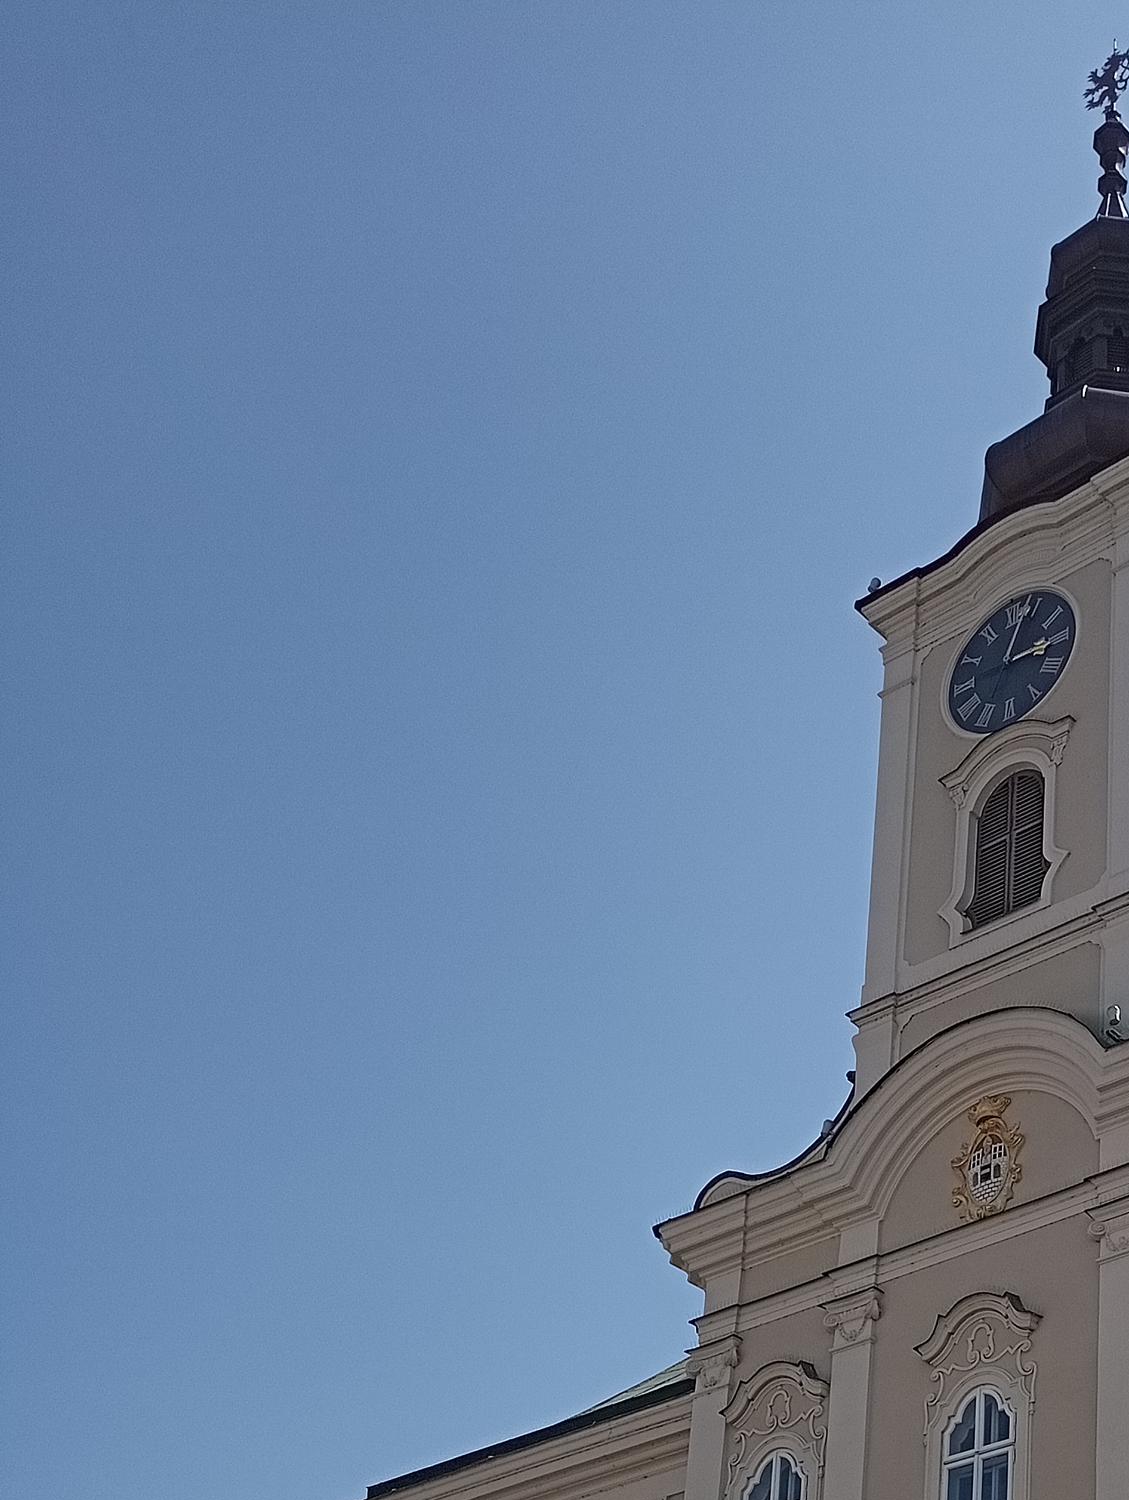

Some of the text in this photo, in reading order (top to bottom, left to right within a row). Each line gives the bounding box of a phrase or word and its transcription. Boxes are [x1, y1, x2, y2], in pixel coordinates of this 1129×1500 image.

[1042, 605, 1063, 630] II
[979, 623, 999, 647] XI
[961, 653, 982, 667] X
[954, 676, 975, 698] IX
[1027, 683, 1043, 702] V
[1003, 697, 1016, 721] VI
